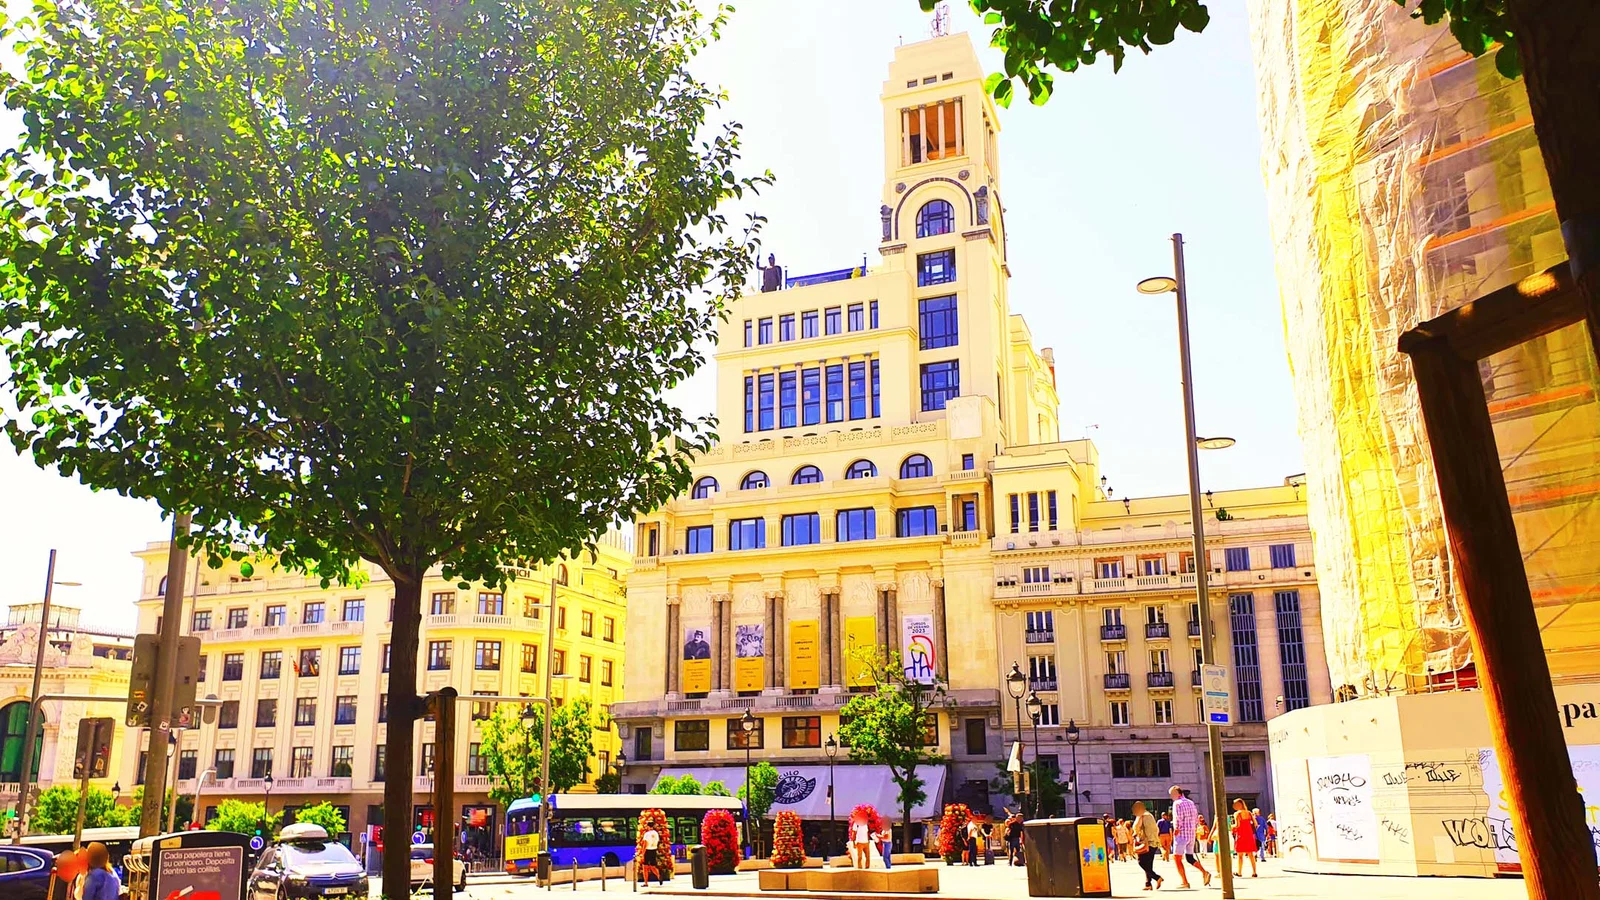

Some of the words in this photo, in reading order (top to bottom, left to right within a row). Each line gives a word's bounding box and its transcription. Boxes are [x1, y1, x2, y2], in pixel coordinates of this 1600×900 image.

[1561, 702, 1600, 728] pa
[802, 780, 815, 798] ARTES
[164, 852, 182, 860] Cada
[184, 851, 212, 860] papelera
[206, 858, 235, 866] Deposita
